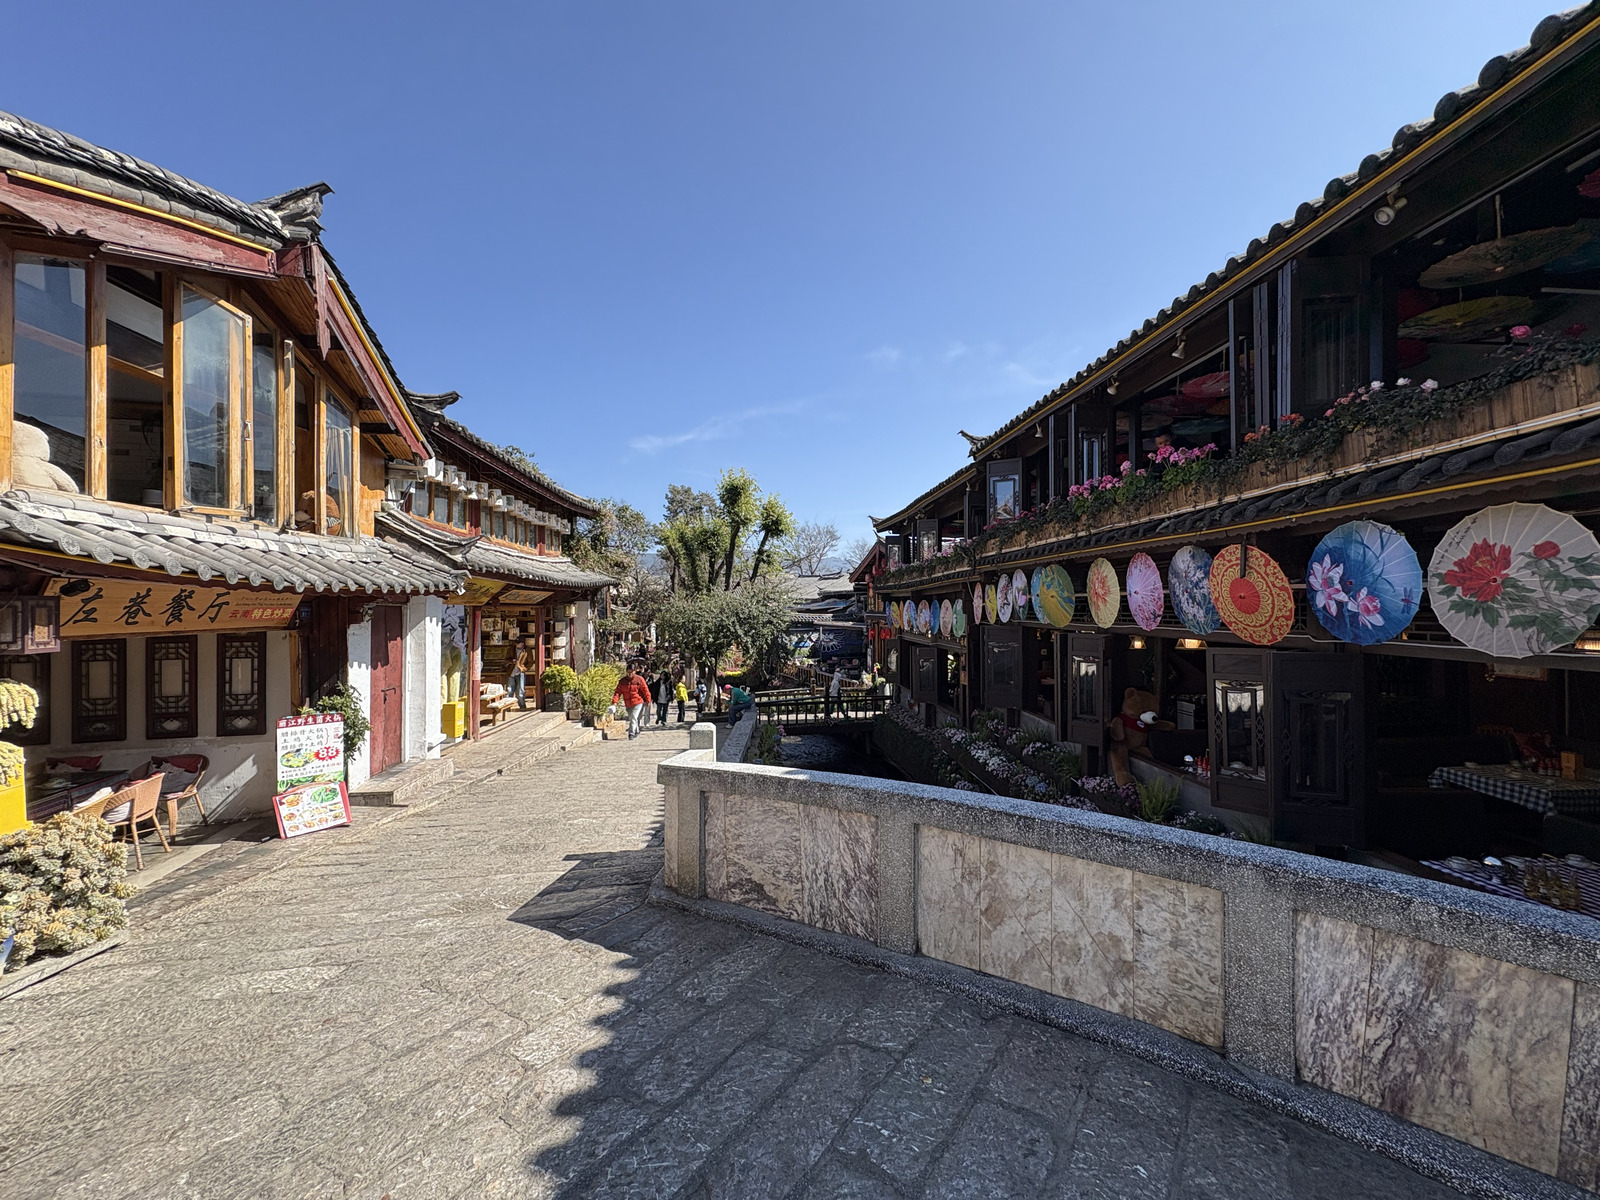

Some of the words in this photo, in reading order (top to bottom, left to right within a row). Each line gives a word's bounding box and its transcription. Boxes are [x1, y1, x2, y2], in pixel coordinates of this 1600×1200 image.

[60, 587, 230, 627] 左巷餐厅
[318, 746, 337, 758] 88
